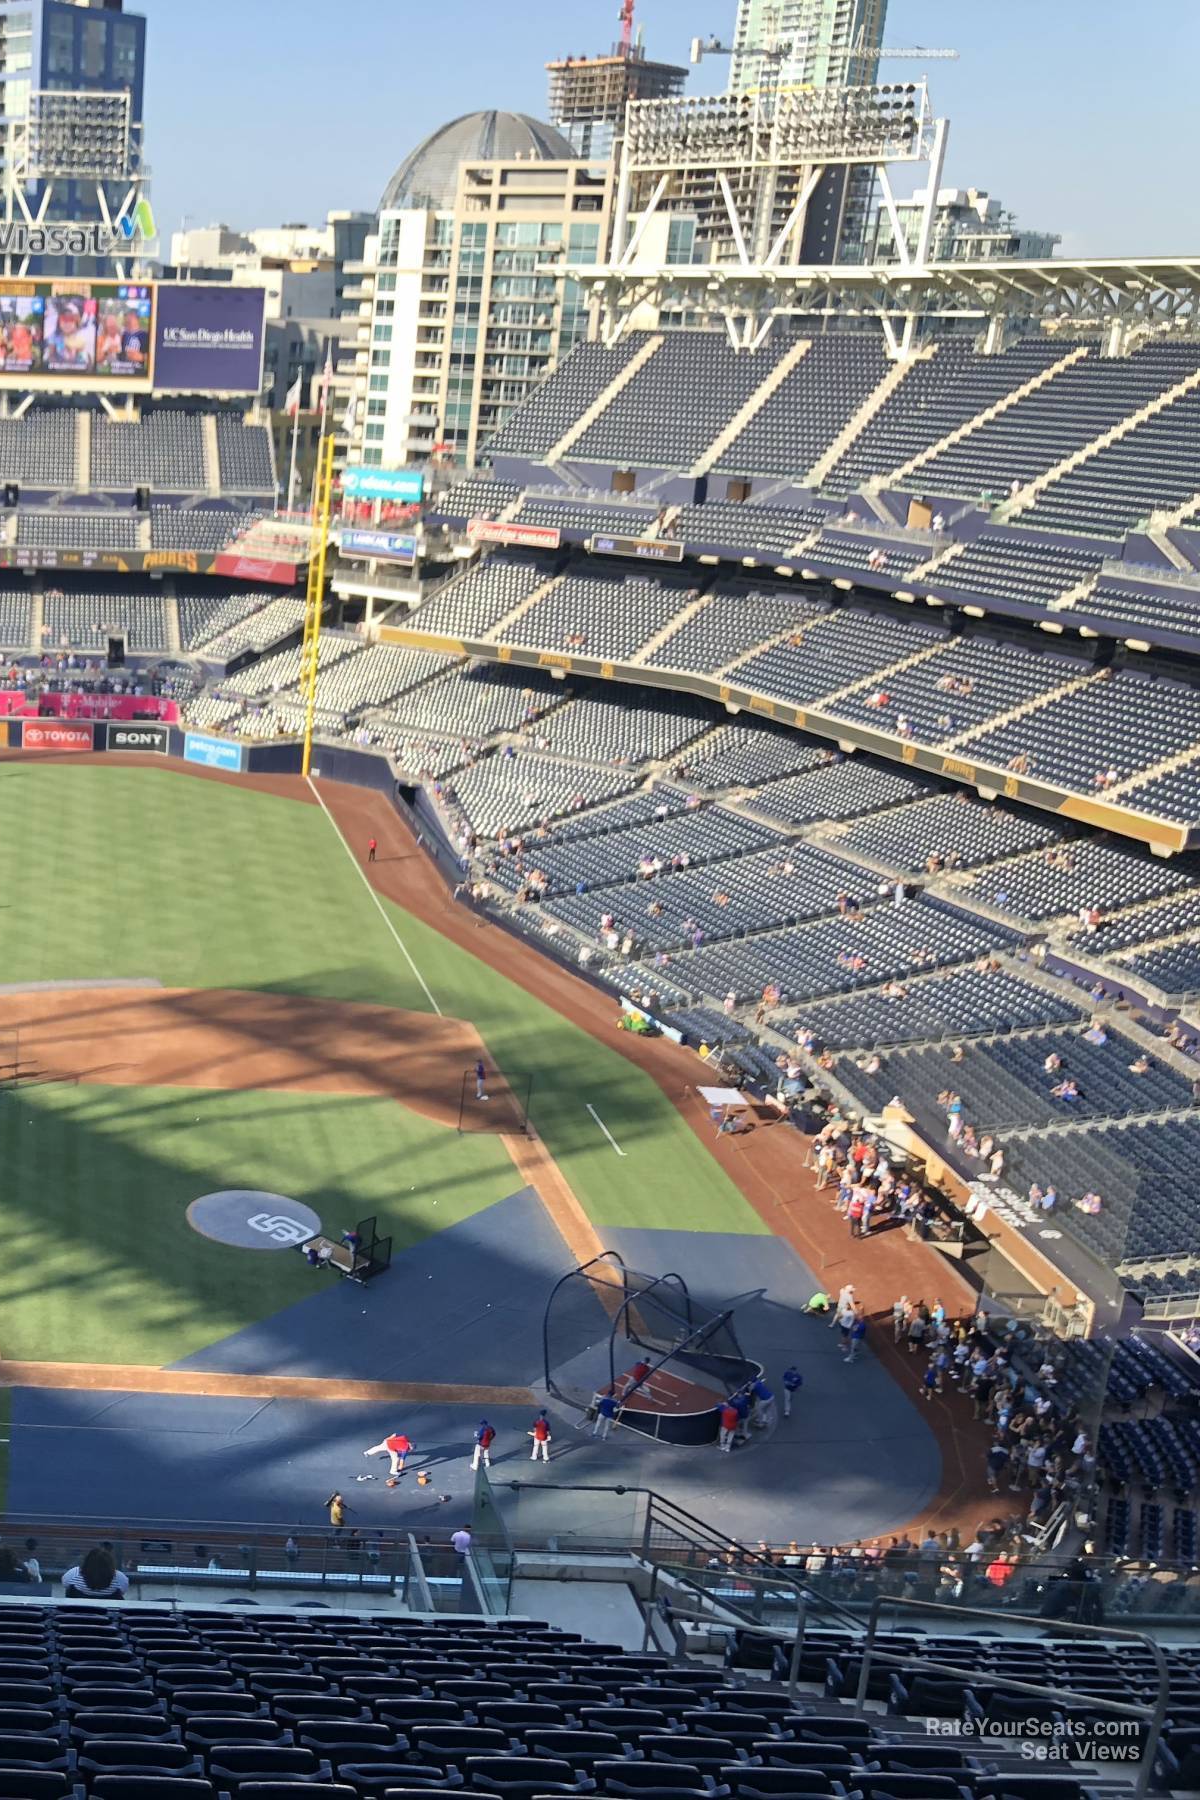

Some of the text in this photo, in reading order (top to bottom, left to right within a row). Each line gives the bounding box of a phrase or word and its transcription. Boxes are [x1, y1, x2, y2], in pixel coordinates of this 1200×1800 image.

[163, 327, 254, 343] UC San Diego Health
[142, 553, 198, 572] PADRES
[45, 730, 90, 742] TOYOTA
[115, 732, 162, 745] SONY
